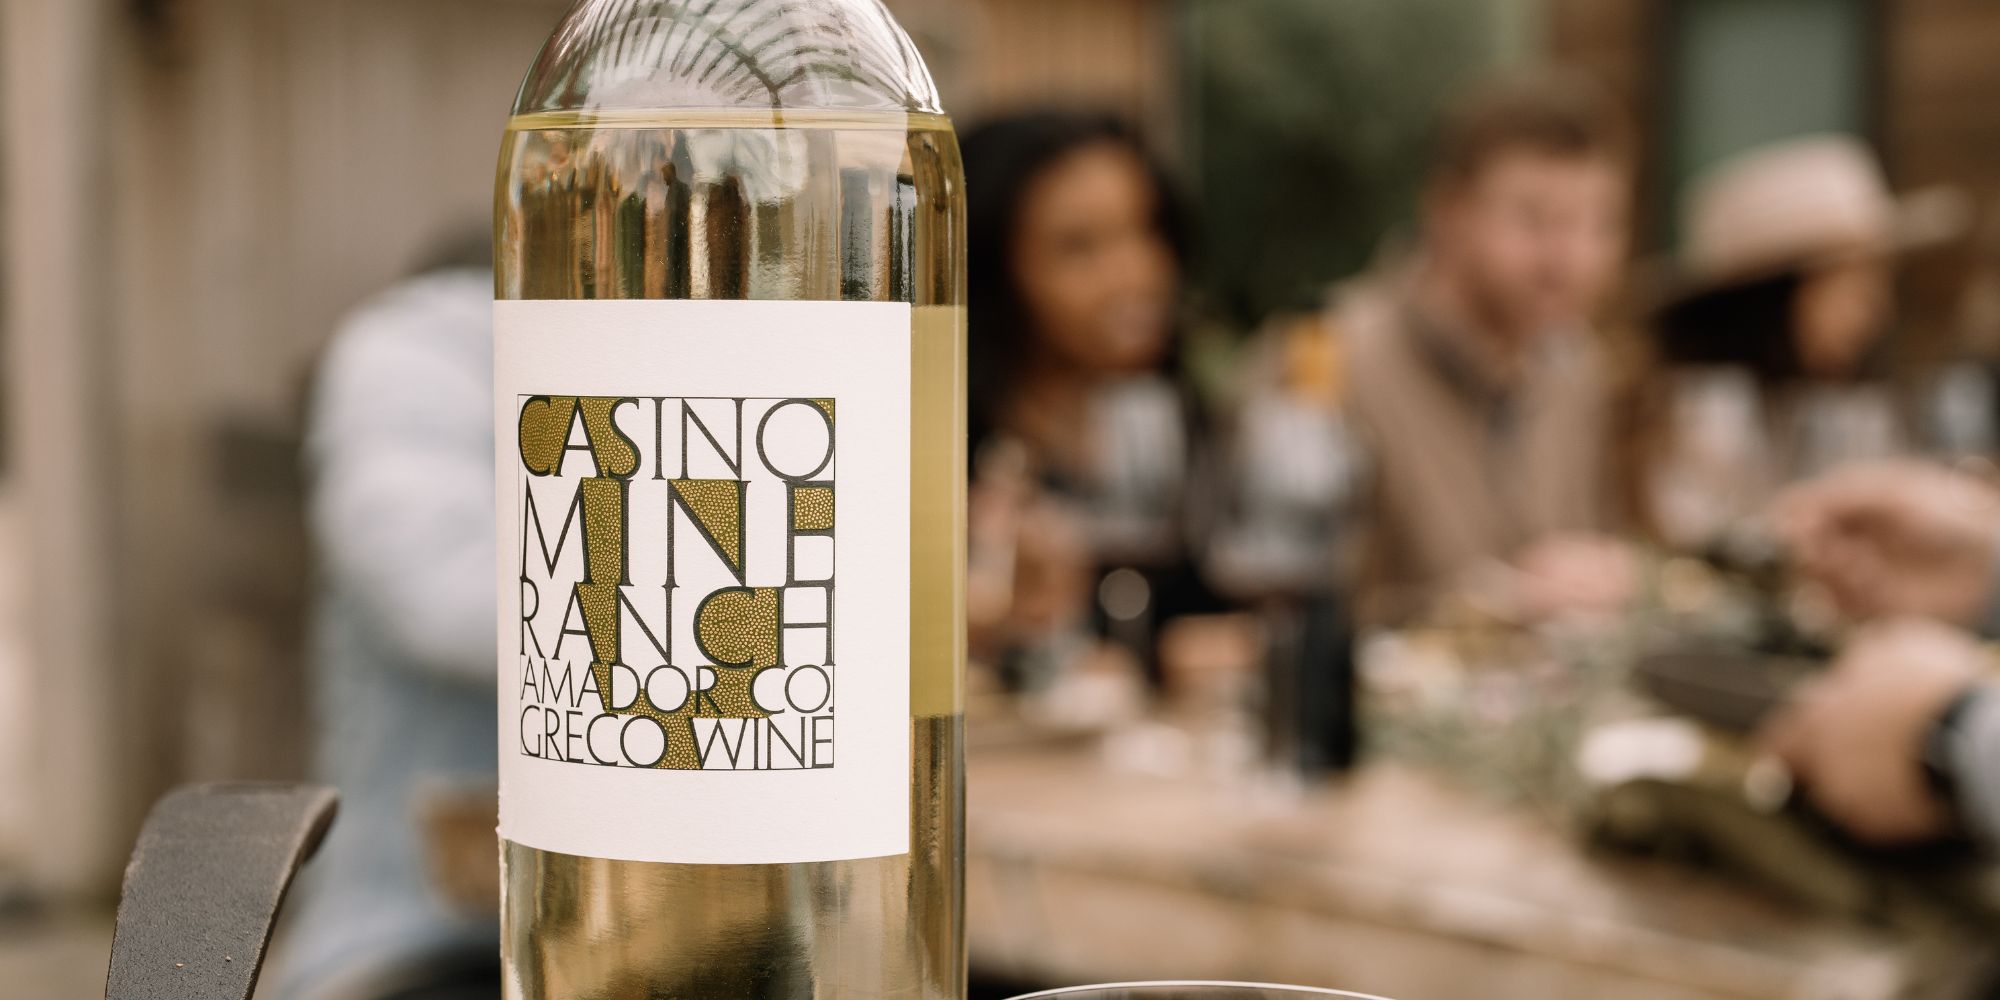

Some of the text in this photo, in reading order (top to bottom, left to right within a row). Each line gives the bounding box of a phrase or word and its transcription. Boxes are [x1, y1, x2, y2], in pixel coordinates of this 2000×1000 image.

[518, 395, 835, 480] CASINO
[519, 475, 835, 587] MINE
[520, 578, 836, 668] RANCH
[521, 655, 834, 714] AMADOR CO.
[521, 705, 834, 769] GRECO WINE
